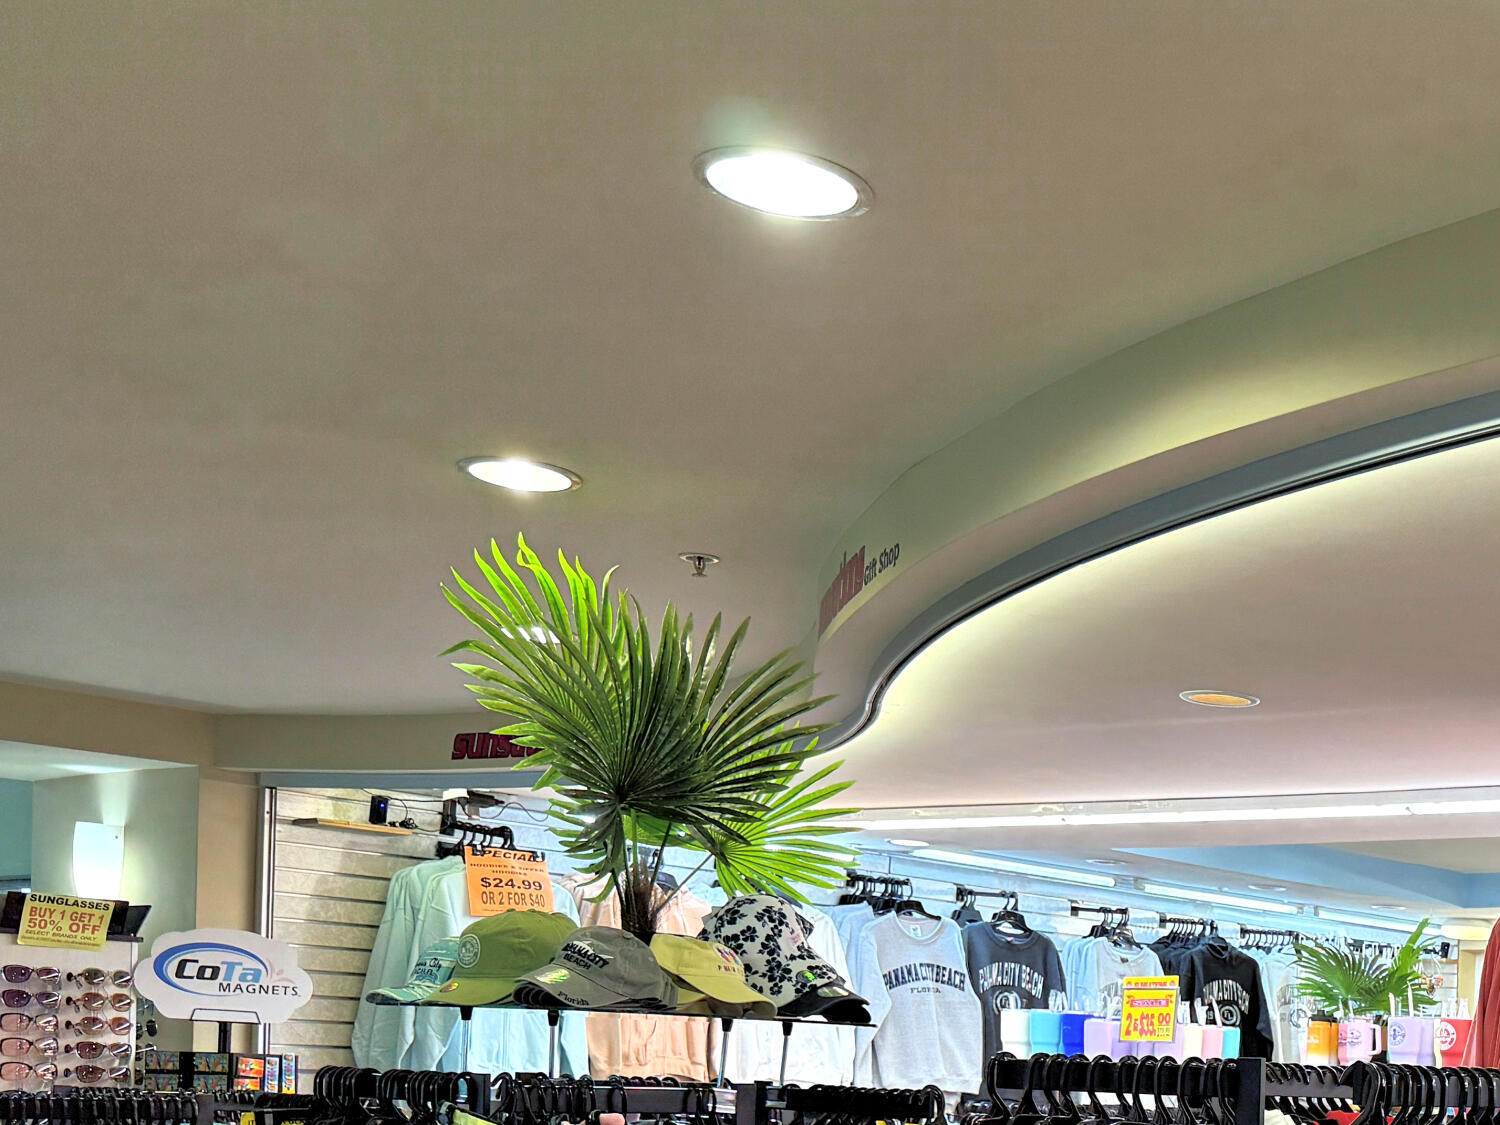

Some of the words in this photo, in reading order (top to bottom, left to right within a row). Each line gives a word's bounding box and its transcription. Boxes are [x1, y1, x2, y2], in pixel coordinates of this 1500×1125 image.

[878, 543, 900, 573] Shop
[480, 877, 542, 891] $24.99
[30, 893, 110, 911] SUNGLASSES
[481, 891, 496, 905] OR
[498, 891, 504, 905] 2
[507, 892, 527, 906] FOR
[529, 893, 545, 908] $40
[29, 906, 56, 919] BUY
[59, 909, 66, 920] 1
[70, 911, 95, 924] GET
[98, 914, 105, 925] 1
[27, 918, 63, 932] 50%
[68, 923, 101, 935] OFF
[175, 958, 263, 983] CoTa
[563, 953, 592, 970] BEACH
[883, 963, 919, 991] PANAMA
[919, 963, 935, 983] CITY
[935, 964, 965, 992] BEACH
[1003, 962, 1021, 987] CITY
[1021, 964, 1044, 1000] BEACH
[218, 981, 299, 998] MAGNETS
[1125, 1012, 1133, 1036] 2
